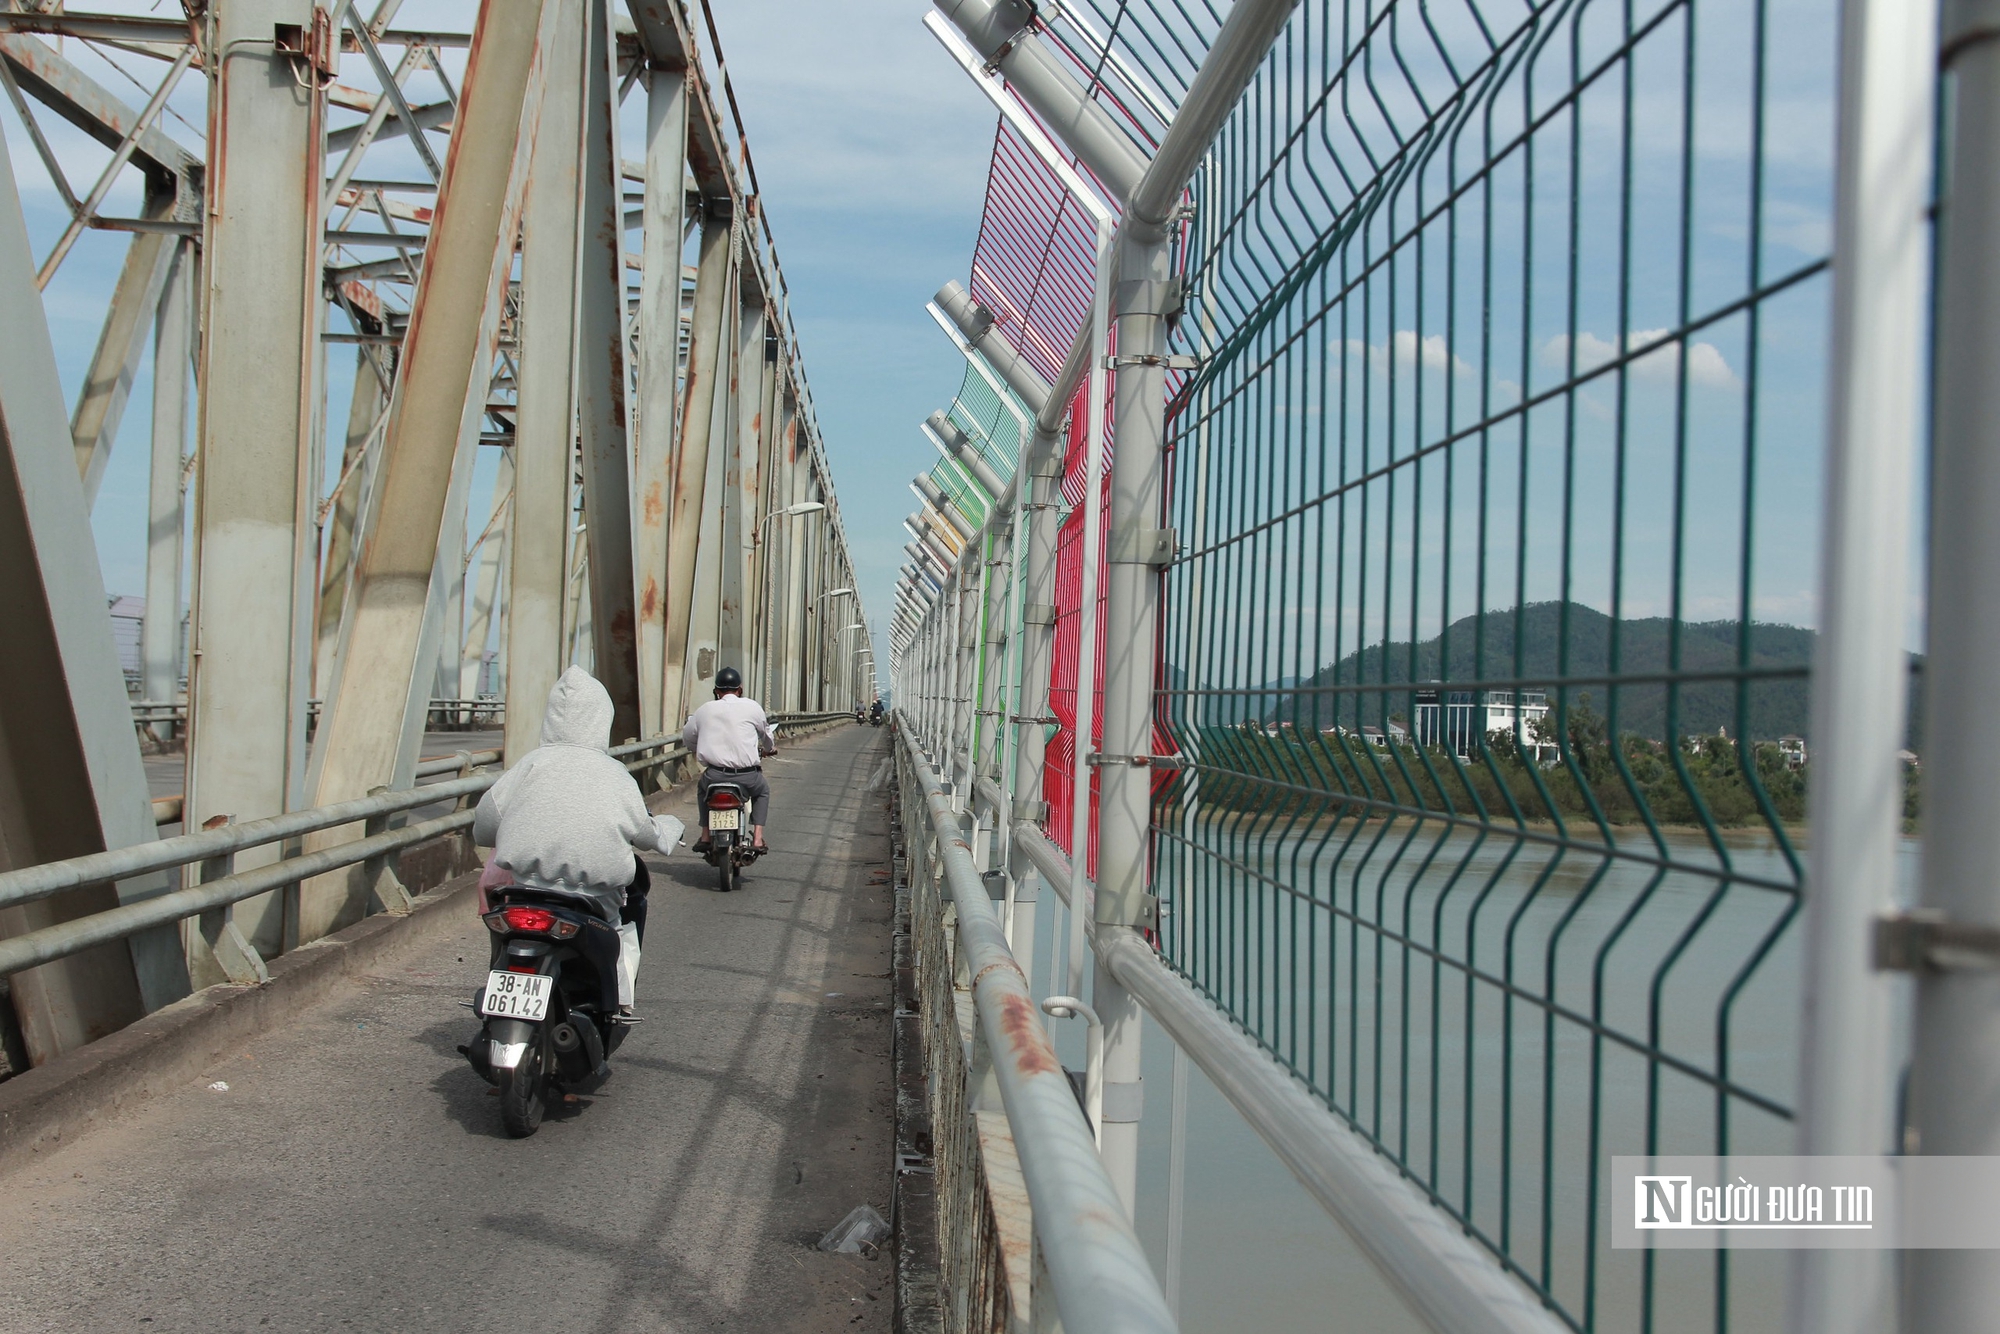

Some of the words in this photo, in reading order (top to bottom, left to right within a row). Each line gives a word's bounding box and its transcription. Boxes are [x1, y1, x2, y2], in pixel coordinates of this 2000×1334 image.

[712, 820, 734, 829] 3125
[497, 974, 542, 997] 38-AN
[487, 994, 543, 1018] 061.42
